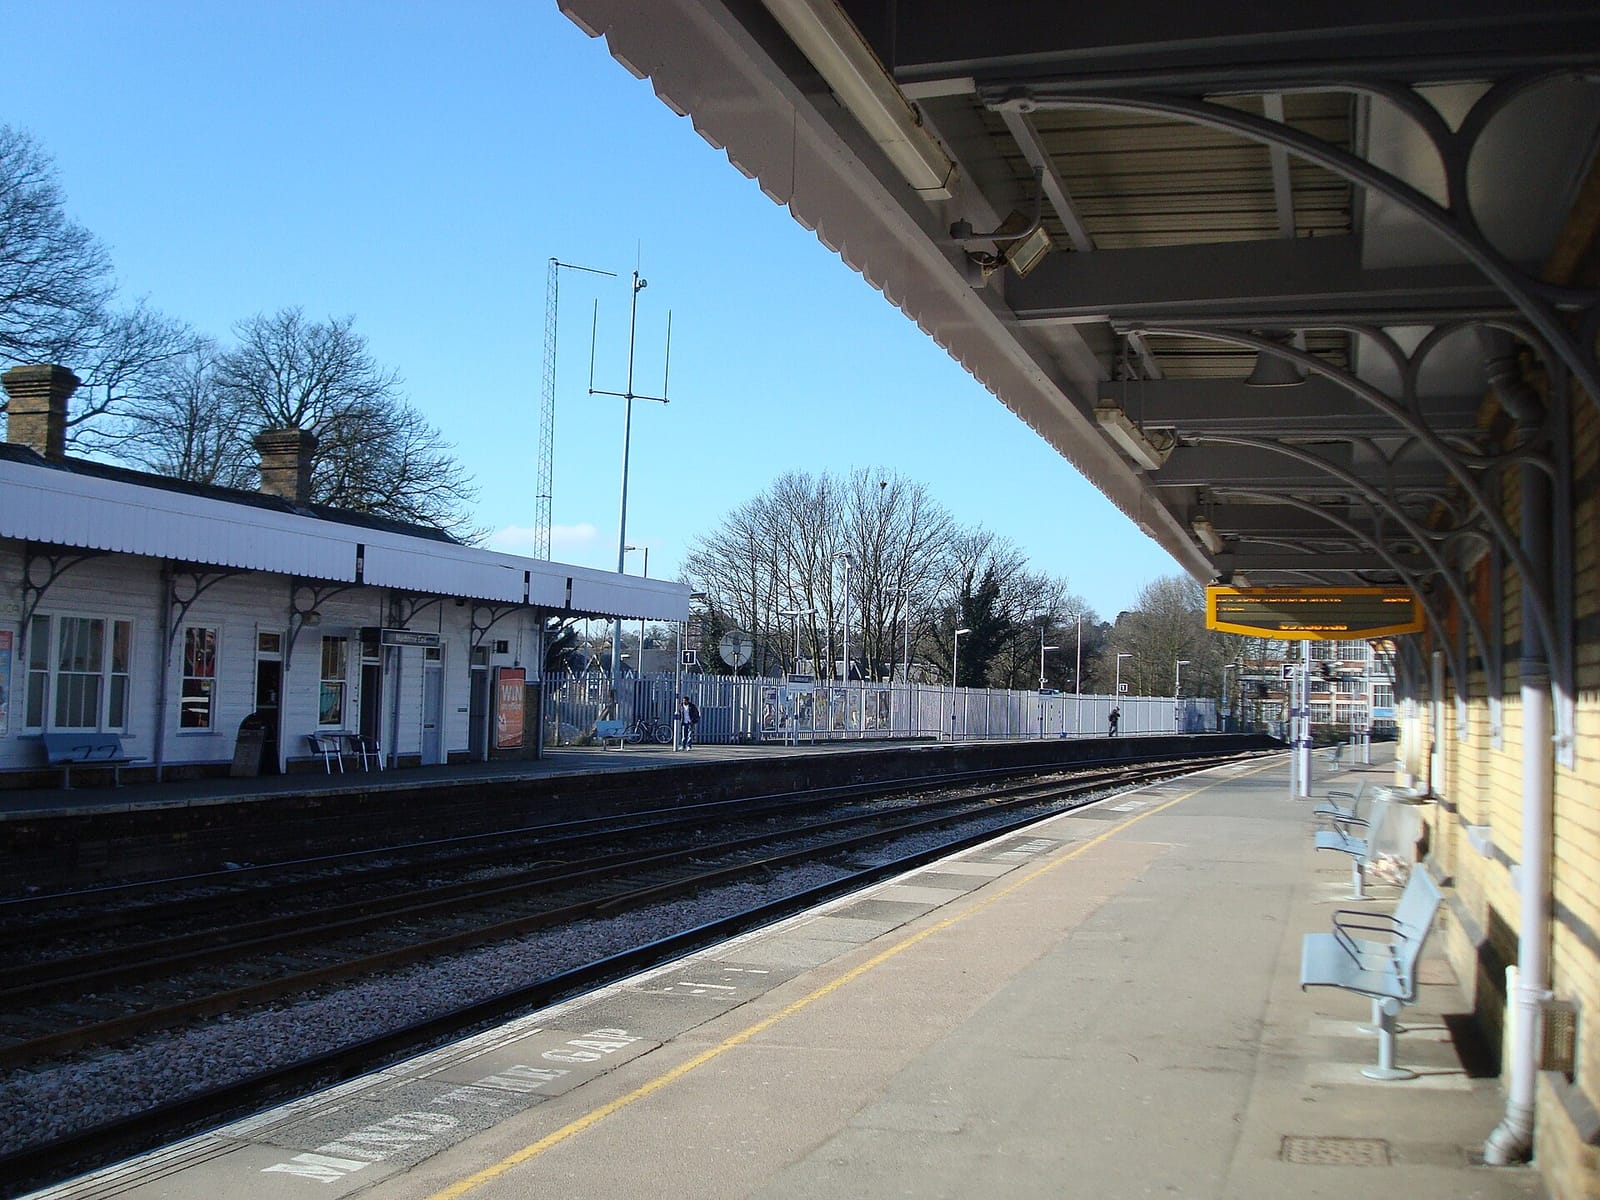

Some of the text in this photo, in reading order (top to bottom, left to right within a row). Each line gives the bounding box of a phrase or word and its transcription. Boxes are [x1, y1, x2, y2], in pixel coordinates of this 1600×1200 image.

[1285, 666, 1294, 678] 2
[502, 685, 522, 701] WIN
[261, 1028, 644, 1184] MIND THE GAP
